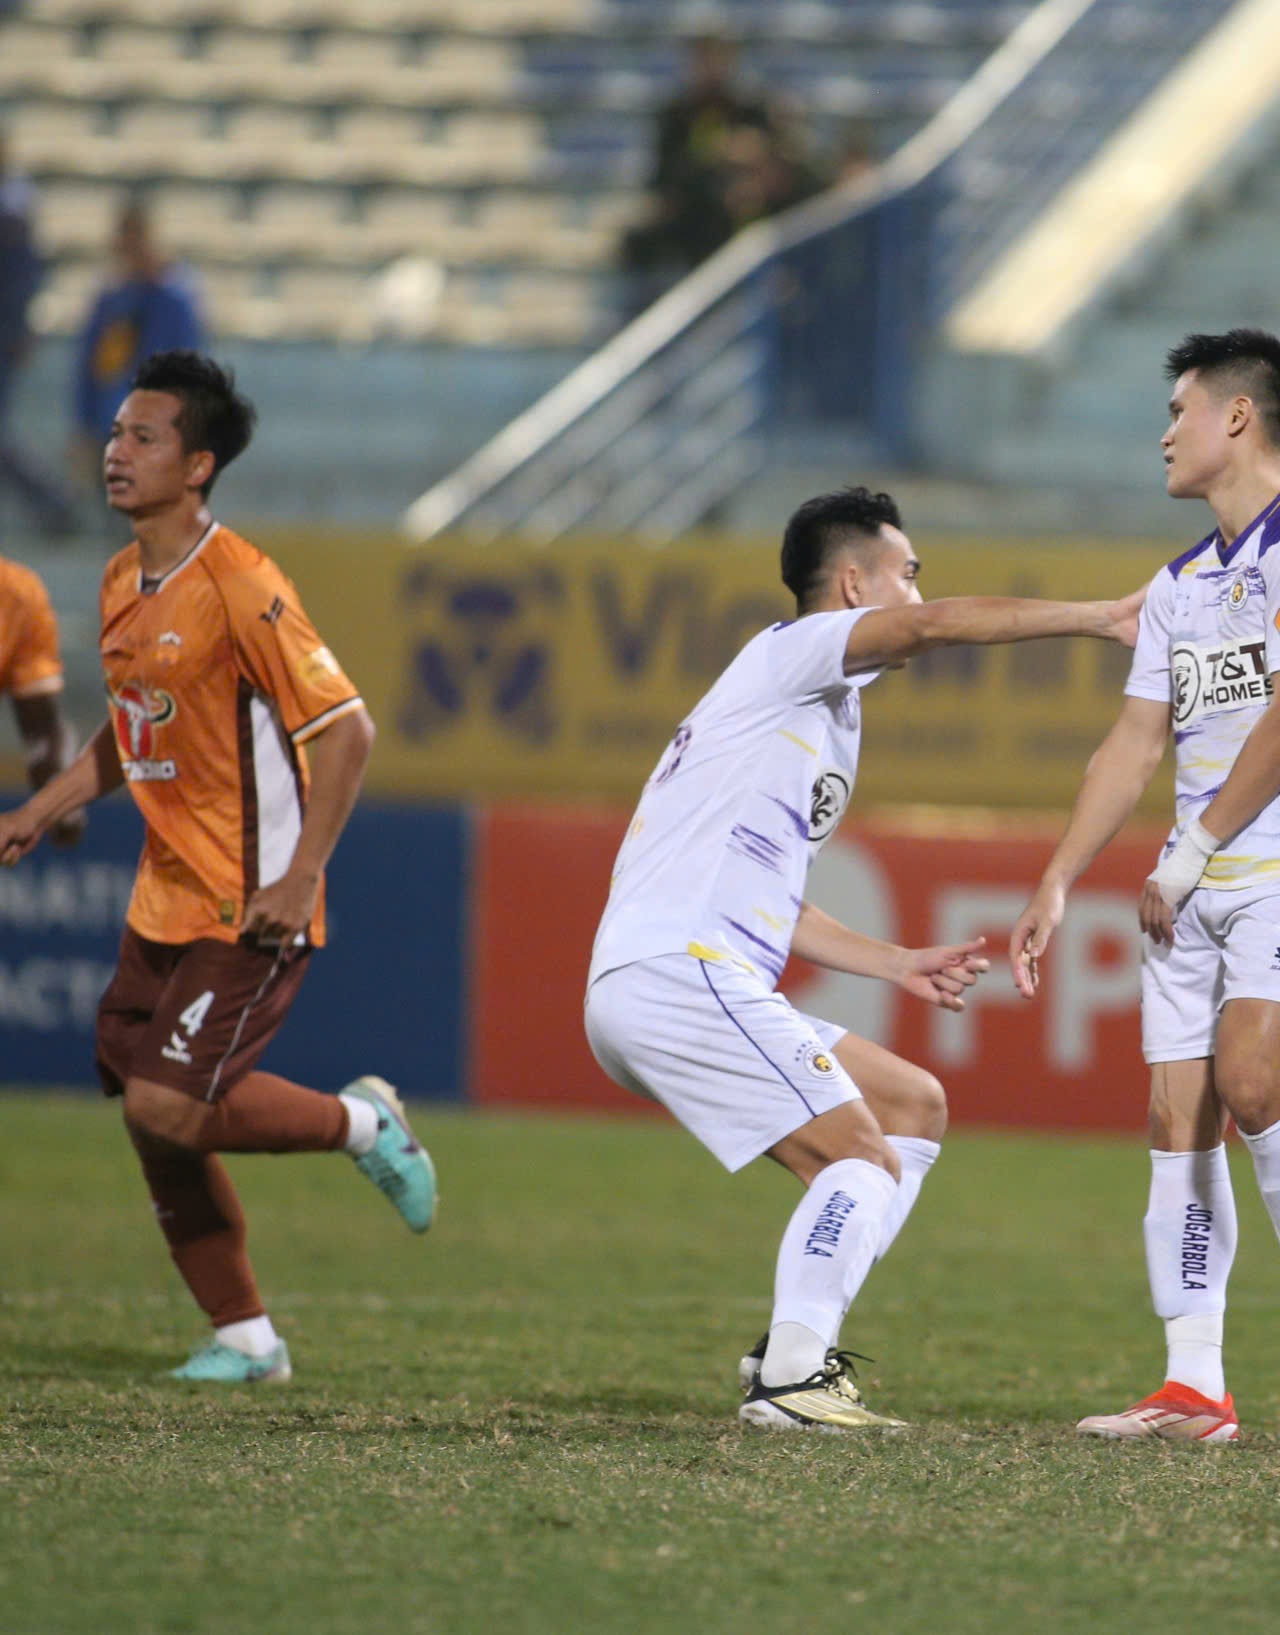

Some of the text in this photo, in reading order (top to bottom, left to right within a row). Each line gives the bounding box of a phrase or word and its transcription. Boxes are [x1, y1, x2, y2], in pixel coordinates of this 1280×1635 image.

[1206, 642, 1265, 684] T&T
[1203, 678, 1274, 707] HOMES
[179, 990, 215, 1037] 4
[803, 1189, 858, 1258] JOGARBOLA
[1181, 1203, 1213, 1290] JOGARBOLA
